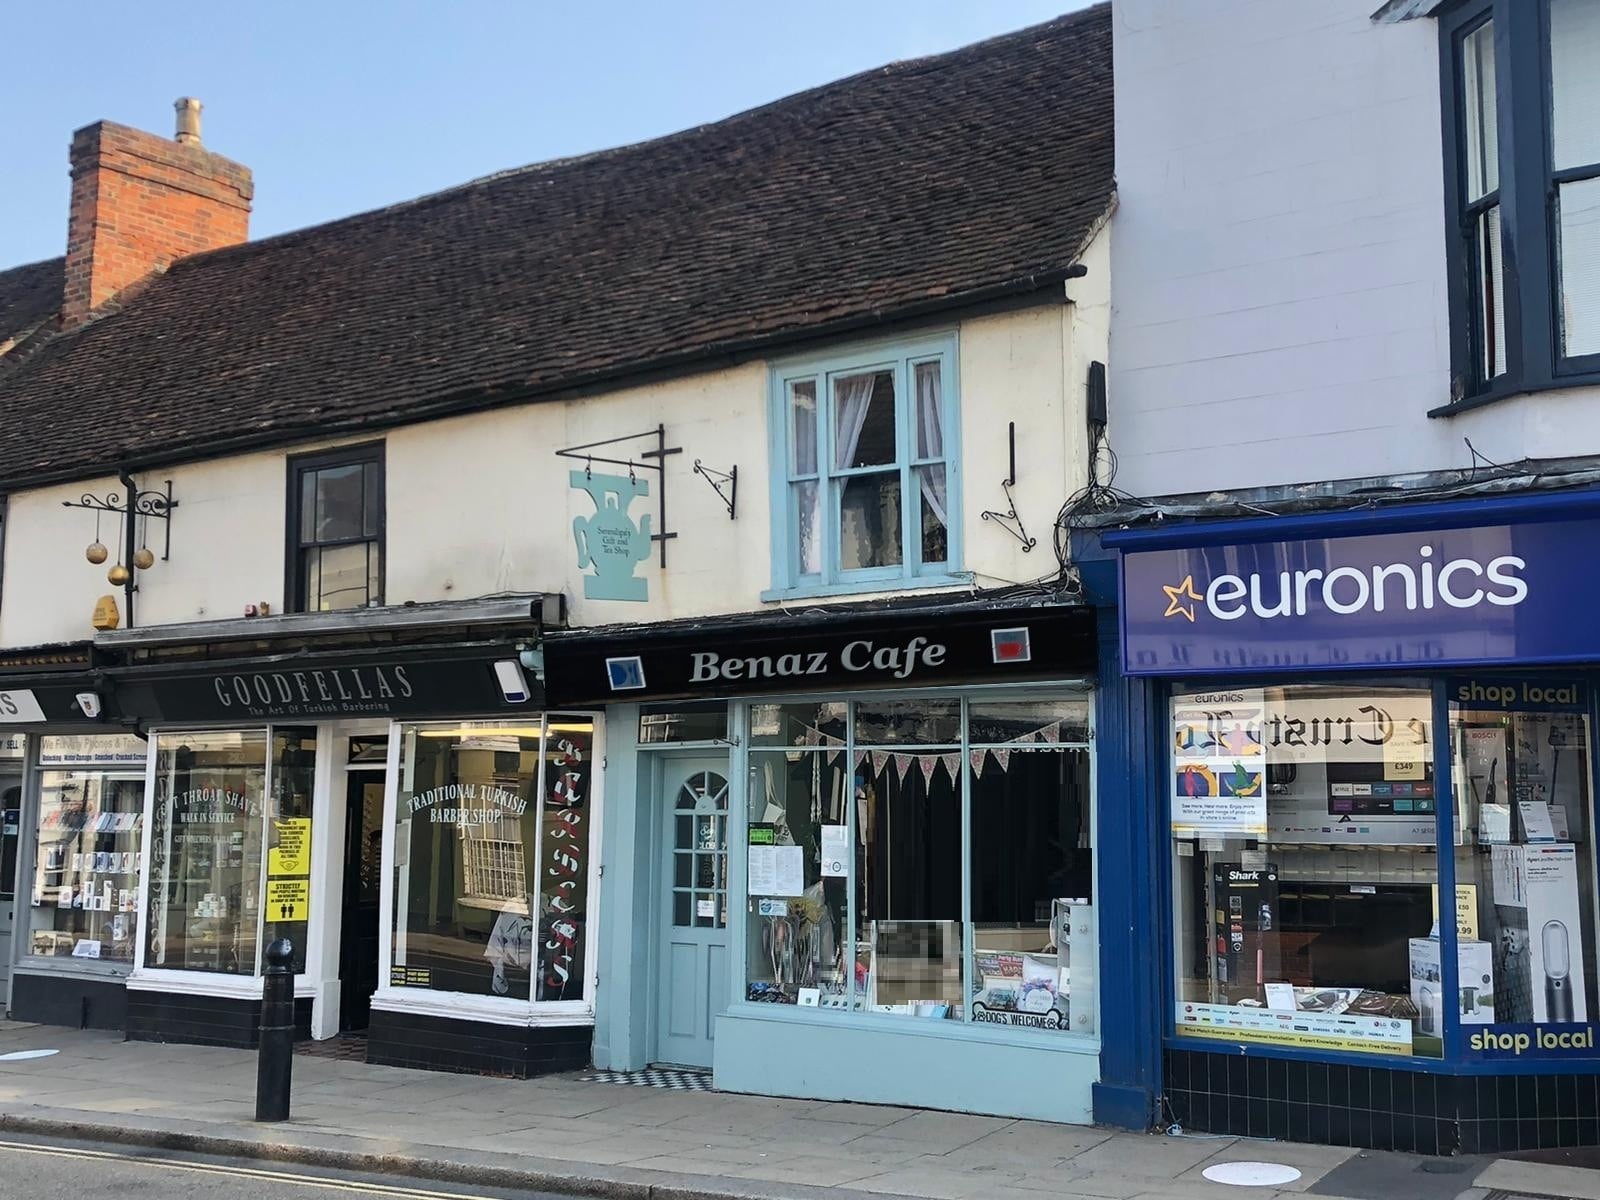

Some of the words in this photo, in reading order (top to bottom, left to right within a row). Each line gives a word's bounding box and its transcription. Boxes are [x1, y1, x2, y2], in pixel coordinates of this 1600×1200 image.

[1207, 545, 1528, 620] euronics
[688, 651, 827, 683] Benaz
[841, 636, 947, 679] Cafe
[214, 665, 413, 706] GOODFELLAS
[1459, 680, 1516, 707] shop
[1522, 682, 1577, 704] local
[1195, 693, 1244, 703] euronics
[249, 706, 264, 715] The
[269, 705, 284, 715] Art
[289, 703, 300, 714] Of
[304, 703, 338, 713] Turkish
[343, 700, 390, 712] Barbering
[1394, 762, 1414, 770] £349
[183, 788, 222, 805] THROAT
[407, 783, 477, 813] TRADITIONAL
[480, 784, 527, 815] TURKISH
[208, 812, 236, 823] SERVICE
[430, 808, 470, 823] BARBER
[473, 810, 500, 823] SHOP
[1229, 871, 1259, 880] Shark
[1010, 1014, 1048, 1028] WELCOME
[1470, 1028, 1530, 1056] shop
[1536, 1026, 1593, 1049] local
